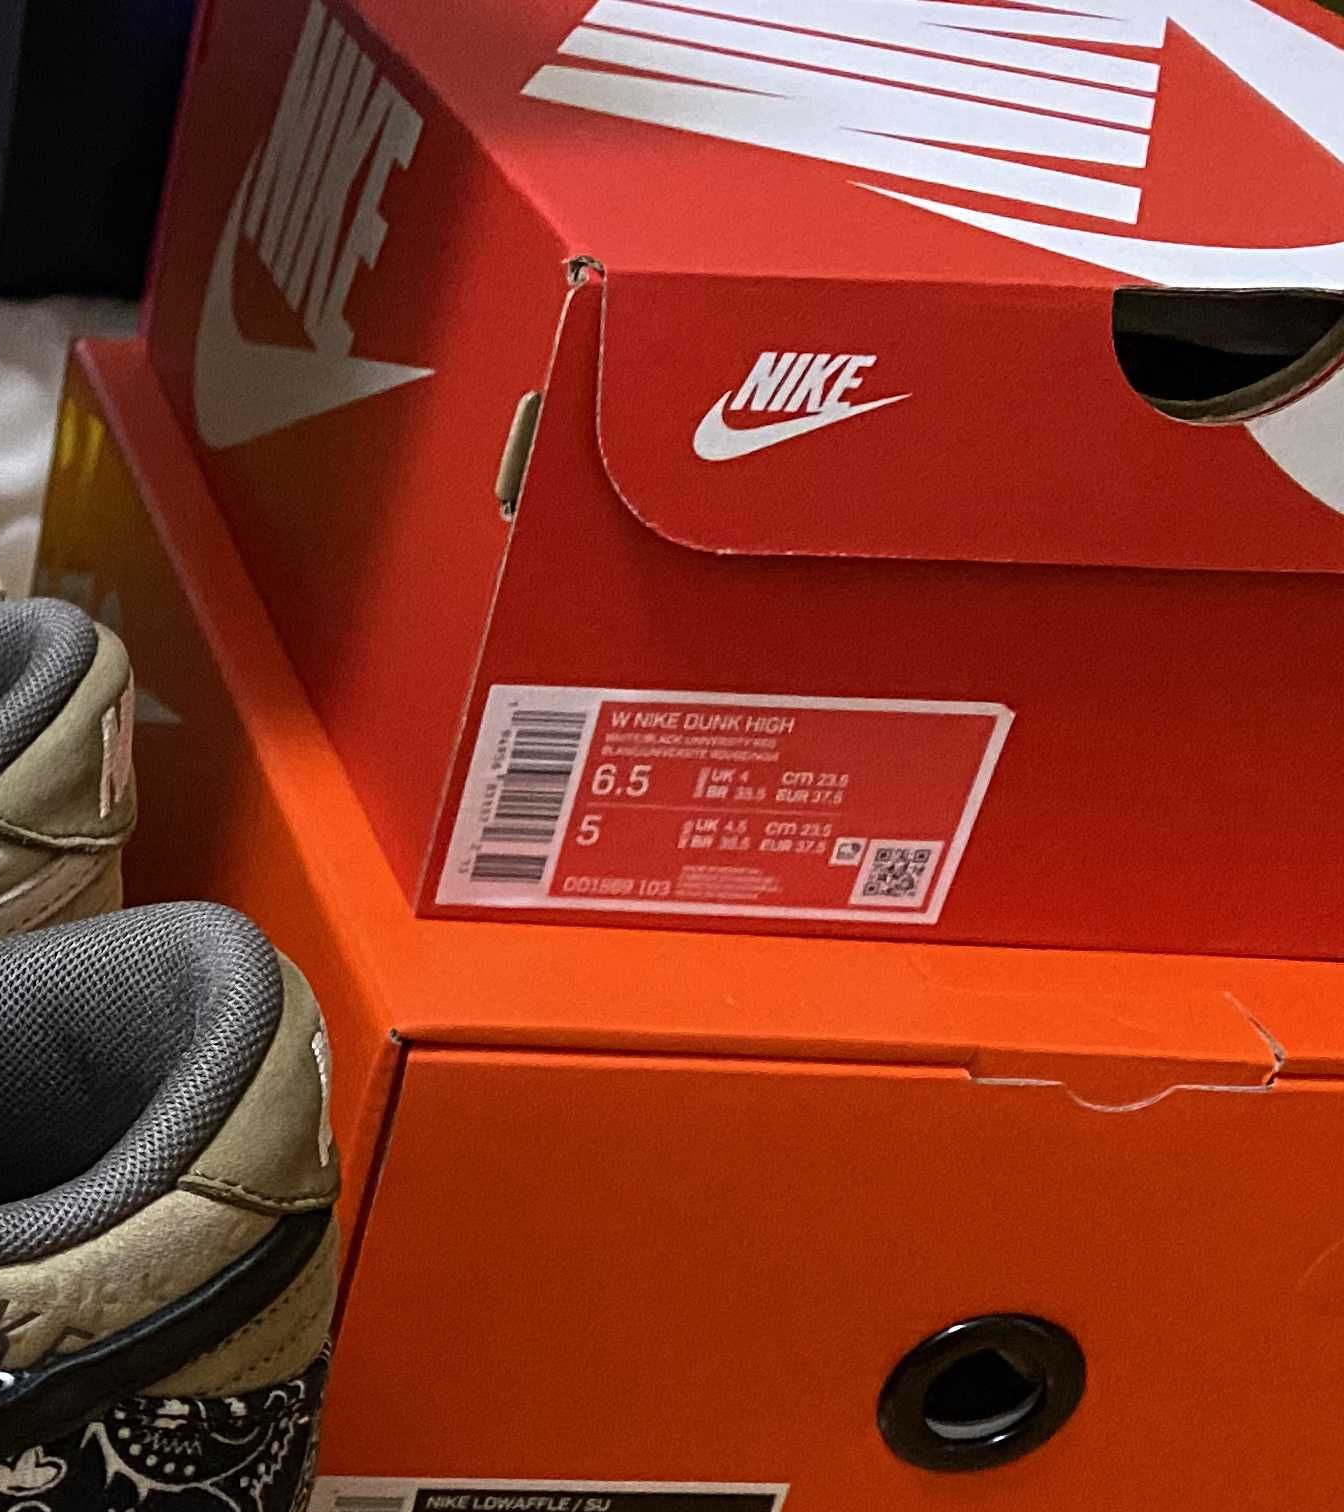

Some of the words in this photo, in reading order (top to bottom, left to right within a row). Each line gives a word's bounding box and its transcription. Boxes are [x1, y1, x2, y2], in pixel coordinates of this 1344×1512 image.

[729, 351, 878, 414] NIKE
[611, 711, 630, 728] W
[632, 712, 682, 730] NIKE
[683, 713, 742, 732] DUNK
[744, 715, 796, 735] HIGH
[591, 763, 653, 798] 6.5
[712, 768, 736, 783] UK
[575, 814, 604, 847] 5
[425, 1495, 471, 1511] NIKE
